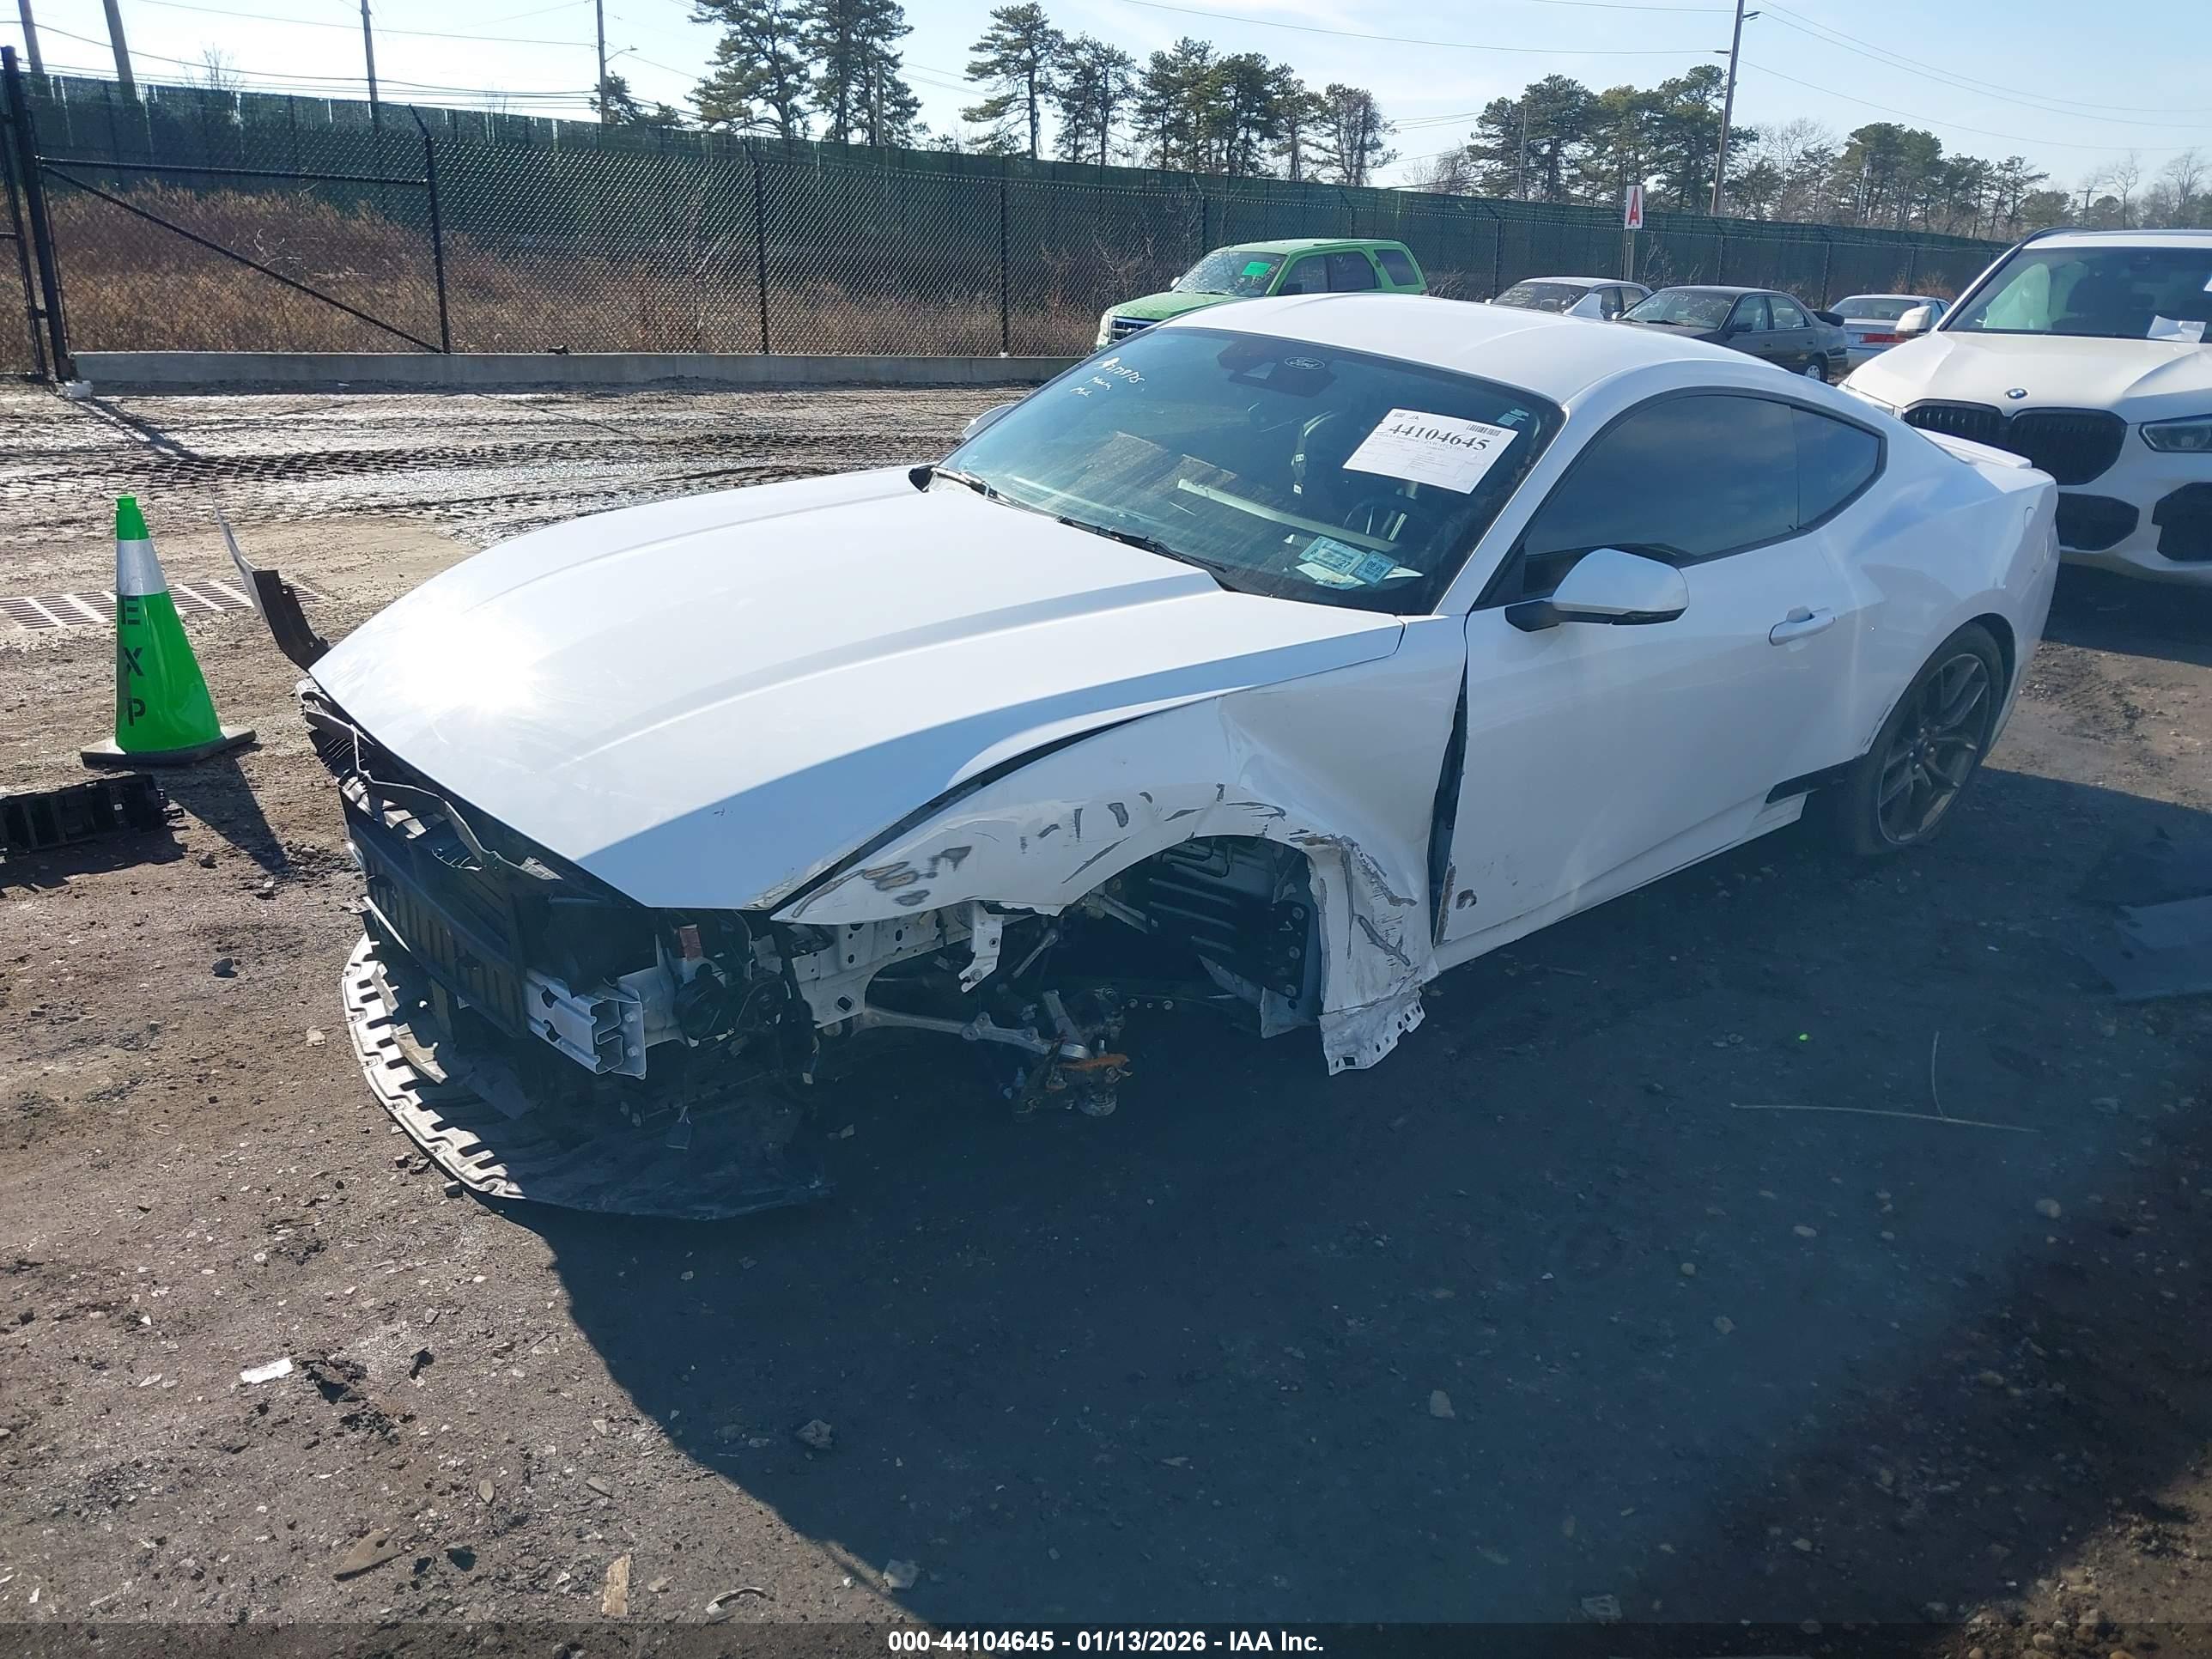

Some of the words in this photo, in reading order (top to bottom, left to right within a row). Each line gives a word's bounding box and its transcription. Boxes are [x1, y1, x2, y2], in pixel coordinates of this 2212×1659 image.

[1627, 186, 1640, 226] A
[1288, 357, 1321, 369] Ford
[1389, 423, 1491, 451] 44104645
[1339, 559, 1352, 568] 27
[122, 596, 147, 727] EXP
